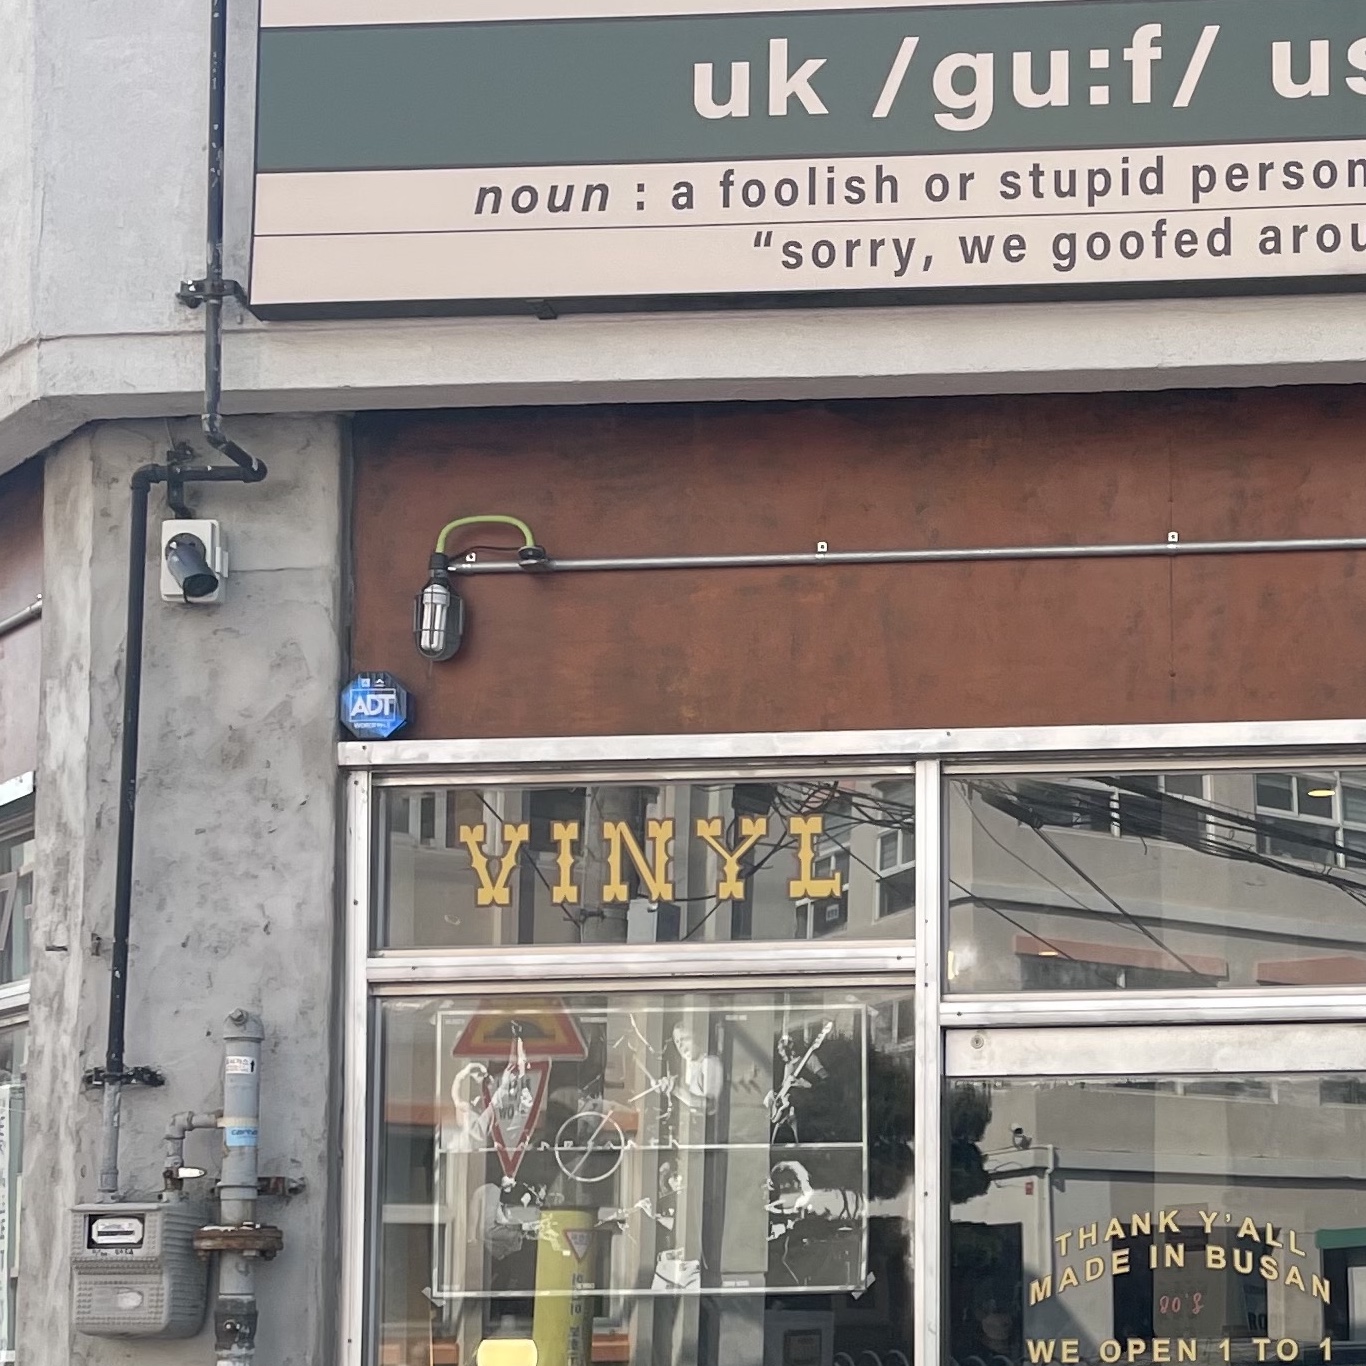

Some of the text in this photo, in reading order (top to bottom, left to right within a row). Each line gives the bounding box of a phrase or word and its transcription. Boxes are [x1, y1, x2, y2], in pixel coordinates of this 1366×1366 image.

[694, 38, 829, 119] uk
[872, 23, 1221, 132] /gu:f/
[474, 183, 609, 215] noun
[671, 181, 694, 211] a
[720, 166, 899, 209] foolish
[925, 171, 975, 203] or
[1000, 155, 1164, 205] stupid
[958, 233, 1027, 264] we
[1052, 218, 1232, 273] goofed
[350, 693, 397, 717] ADT
[459, 815, 841, 906] VINYL
[1055, 1210, 1180, 1257] THANK
[1029, 1243, 1331, 1306] MADE IN BUSAN
[1028, 1337, 1332, 1363] WE OPEN 1 TO 1
